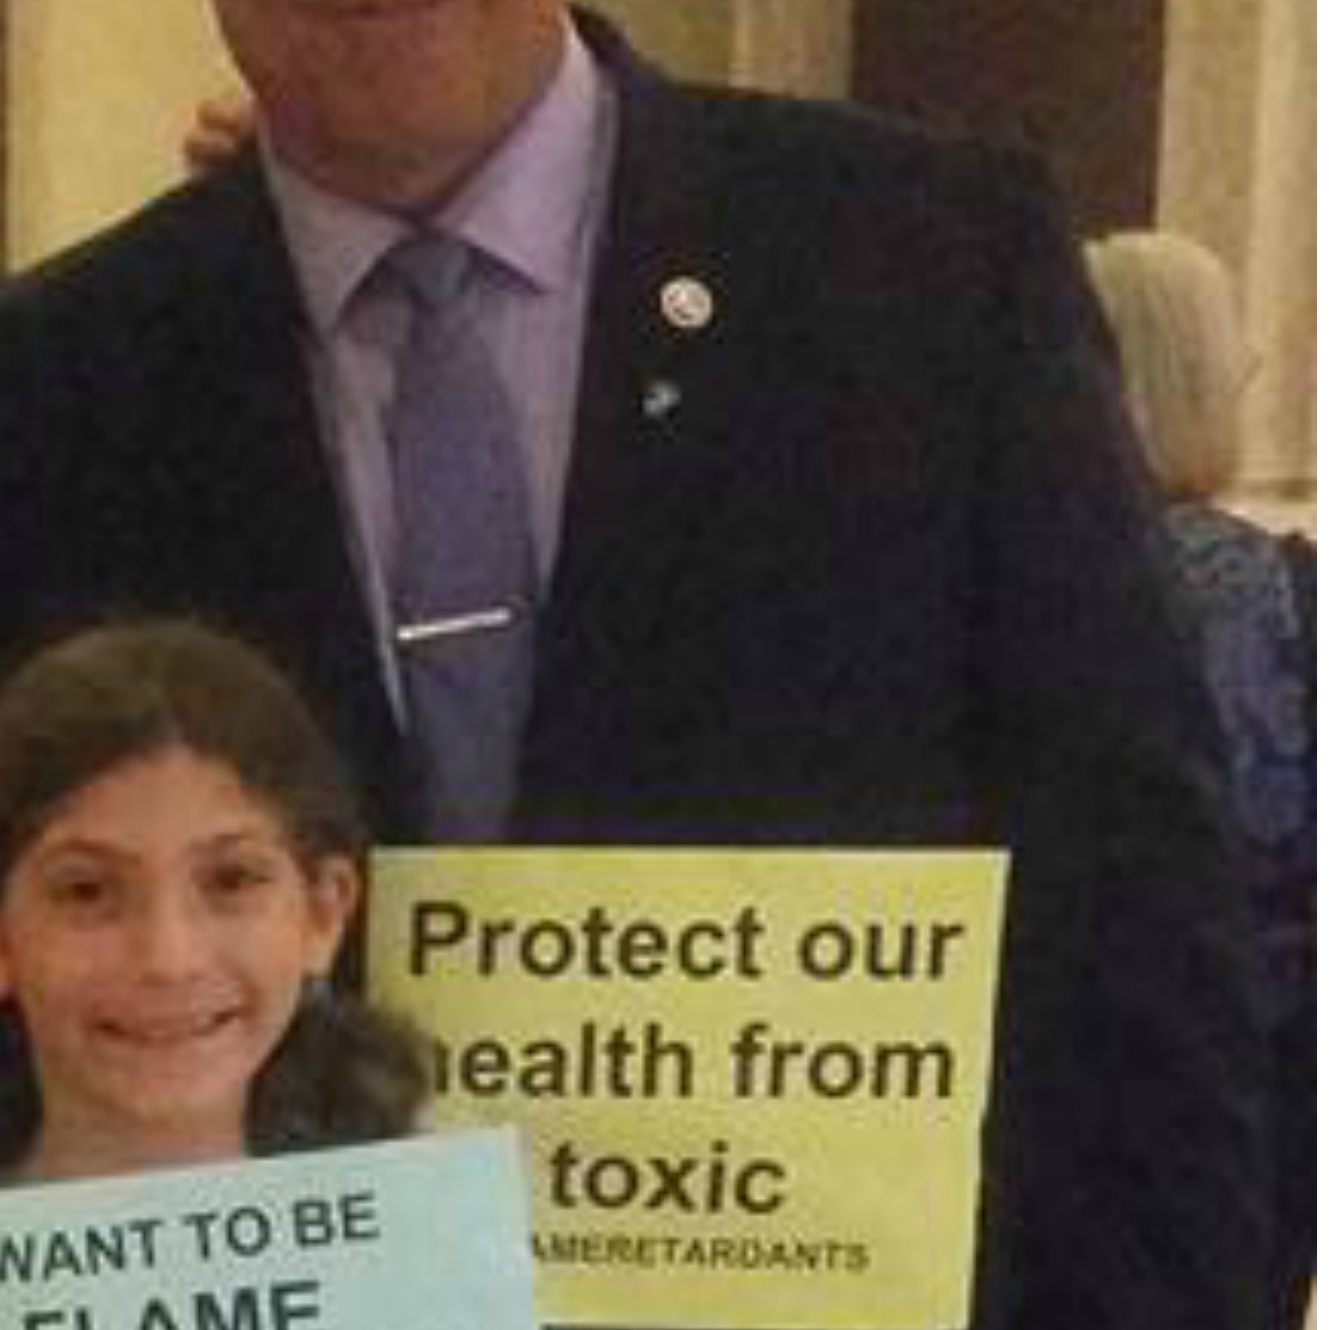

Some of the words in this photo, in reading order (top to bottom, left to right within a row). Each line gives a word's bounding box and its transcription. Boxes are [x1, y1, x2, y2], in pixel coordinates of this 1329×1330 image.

[408, 900, 767, 982] Protect
[798, 920, 965, 983] our
[730, 1021, 955, 1099] from
[548, 1141, 788, 1214] toxic
[184, 1206, 271, 1260] TO
[293, 1191, 380, 1248] BE
